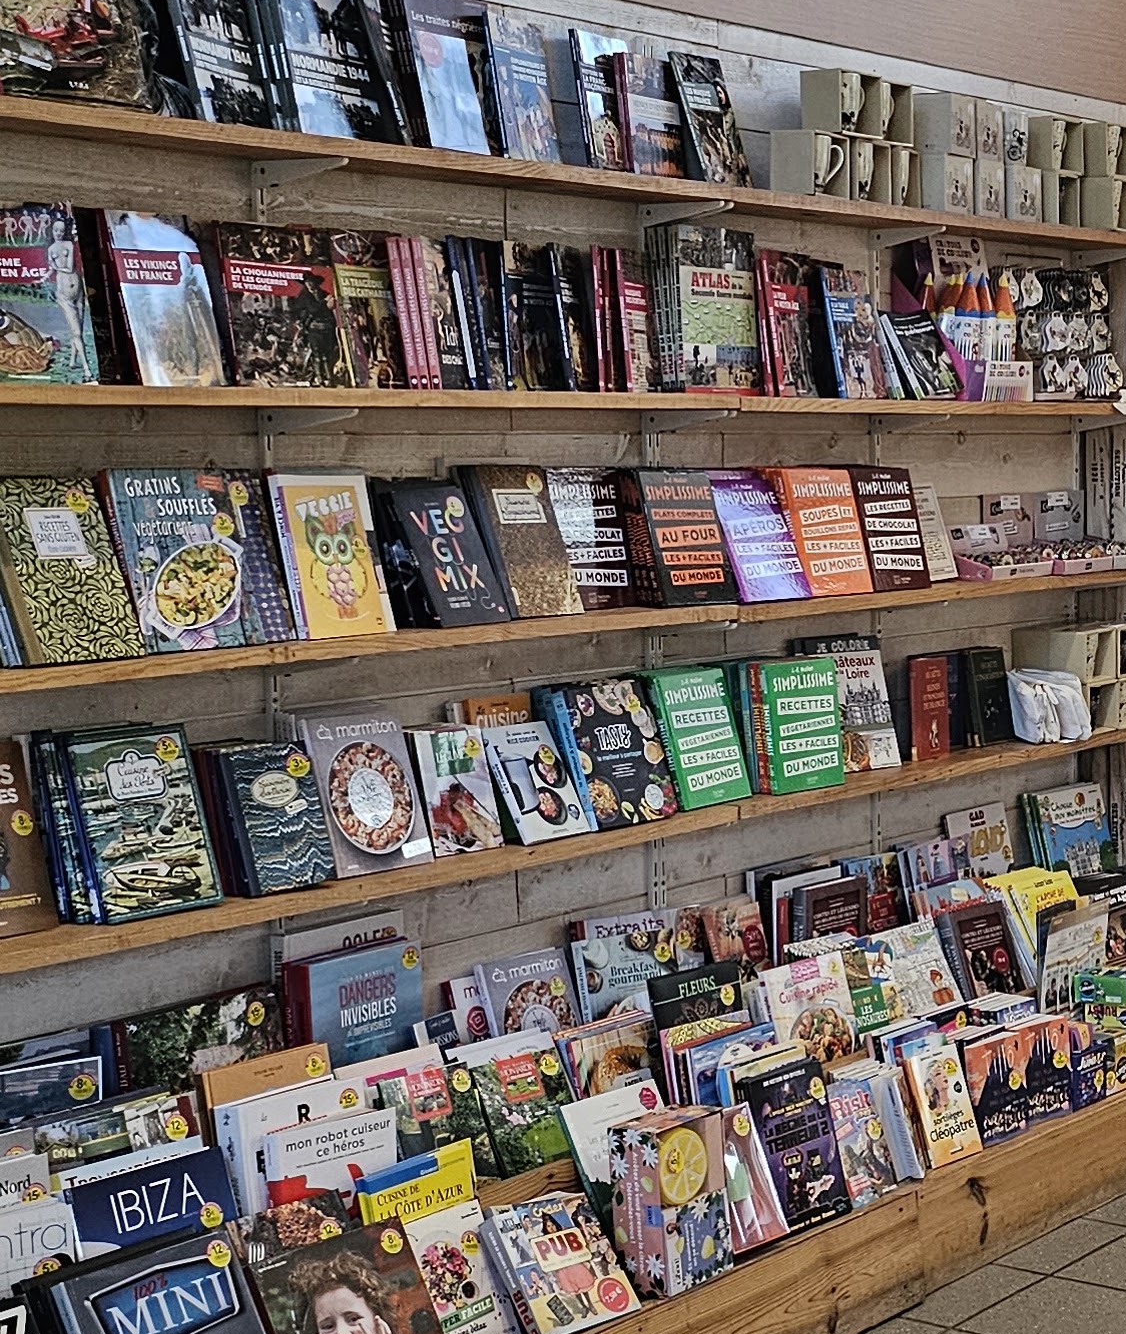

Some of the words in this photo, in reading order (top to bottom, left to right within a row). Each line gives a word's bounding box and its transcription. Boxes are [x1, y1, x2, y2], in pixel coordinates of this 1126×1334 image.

[349, 64, 370, 83] 1944
[123, 258, 139, 270] LES
[140, 259, 178, 271] VIKINGS
[126, 271, 140, 280] EN
[142, 270, 174, 281] FRANCE
[230, 266, 241, 275] LA
[243, 267, 303, 281] CHOUANNERIE
[691, 271, 730, 289] ATLAS
[124, 476, 181, 498] GRATINS
[645, 485, 711, 501] SIMPLISSIME
[792, 482, 851, 498] SIMPLISSIME
[857, 481, 911, 496] SIMPLISSIME
[157, 497, 217, 517] SOUFFLÉS
[654, 510, 675, 518] PLATS
[676, 510, 713, 519] COMPLETS
[866, 504, 878, 513] LES
[879, 500, 910, 511] RECETTES
[802, 508, 839, 523] SOUPES
[38, 521, 70, 532] RECETTES
[867, 520, 877, 529] DE
[878, 520, 916, 530] CHOCOLAT
[54, 532, 81, 543] GLUTEN
[661, 531, 679, 544] AU
[683, 528, 717, 542] FOUR
[871, 538, 885, 548] LES
[889, 537, 919, 547] FACILES
[761, 544, 794, 554] FACILES
[806, 543, 821, 551] LES
[829, 540, 861, 551] FACILES
[586, 549, 624, 560] FACILES
[665, 554, 681, 563] LES
[688, 553, 722, 563] FACILES
[875, 556, 890, 567] DU
[890, 556, 922, 568] MONDE
[763, 560, 802, 574] MONDE
[812, 563, 827, 574] DU
[828, 557, 864, 571] MONDE
[435, 564, 486, 592] MIX
[587, 572, 626, 584] MONDE
[673, 572, 687, 583] DU
[689, 570, 722, 582] MONDE
[817, 642, 827, 653] JE
[831, 639, 870, 652] COLORIE
[773, 671, 834, 692] SIMPLISSIME
[845, 668, 870, 679] Loire
[664, 682, 726, 706] SIMPLISSIME
[780, 698, 832, 711] RECETTES
[476, 709, 530, 728] cuisine
[674, 709, 727, 725] RECETTES
[335, 718, 397, 739] marmiton
[594, 724, 632, 750] TASTY
[781, 741, 797, 751] LES
[805, 736, 837, 748] FACILES
[682, 755, 698, 766] LES
[706, 749, 738, 762] FACILES
[786, 762, 800, 774] DU
[802, 755, 837, 770] MONDE
[690, 777, 704, 789] DU
[707, 767, 740, 785] MONDE
[595, 917, 665, 940] Extraits
[508, 958, 563, 979] marmiton
[338, 973, 397, 1008] DANGERS
[678, 974, 717, 999] FLEURS
[778, 985, 811, 1005] Cuisine
[340, 996, 397, 1028] INVISIBLES
[829, 1088, 872, 1120] Risk
[286, 1137, 313, 1153] mon
[315, 1128, 348, 1146] robot
[351, 1119, 391, 1138] cuiseur
[929, 1116, 975, 1144] Cléopâtre
[316, 1147, 329, 1158] ce
[332, 1136, 365, 1155] héros
[0, 1174, 31, 1198] Nord
[110, 1172, 205, 1235] IBIZA
[377, 1186, 409, 1208] CUISINE
[410, 1183, 421, 1196] DE
[393, 1199, 422, 1219] CÔTE
[423, 1183, 464, 1208] D'AZUR
[535, 1230, 584, 1262] PUB
[461, 1297, 493, 1320] FACILE
